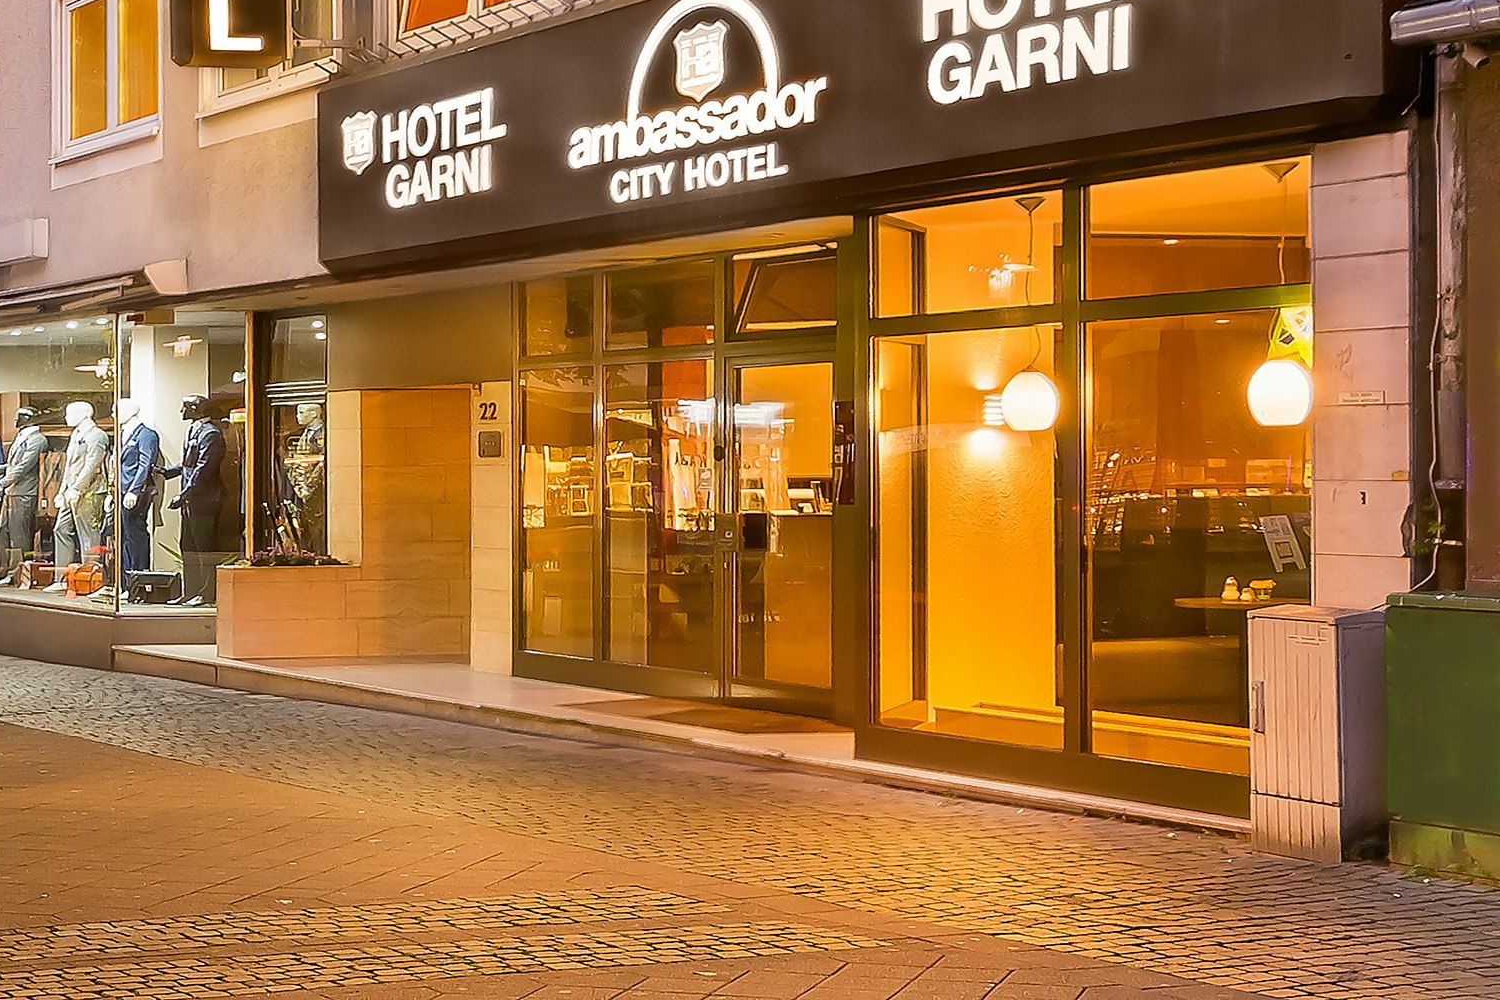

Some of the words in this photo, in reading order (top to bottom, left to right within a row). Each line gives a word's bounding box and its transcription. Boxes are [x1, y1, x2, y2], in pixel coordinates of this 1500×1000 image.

[927, 3, 1133, 105] GARNI
[381, 87, 507, 164] HOTEL
[567, 75, 828, 170] ambassador
[385, 143, 493, 209] GARNI
[610, 158, 677, 204] CITY
[684, 141, 789, 191] HOTEL
[479, 402, 497, 420] 22
